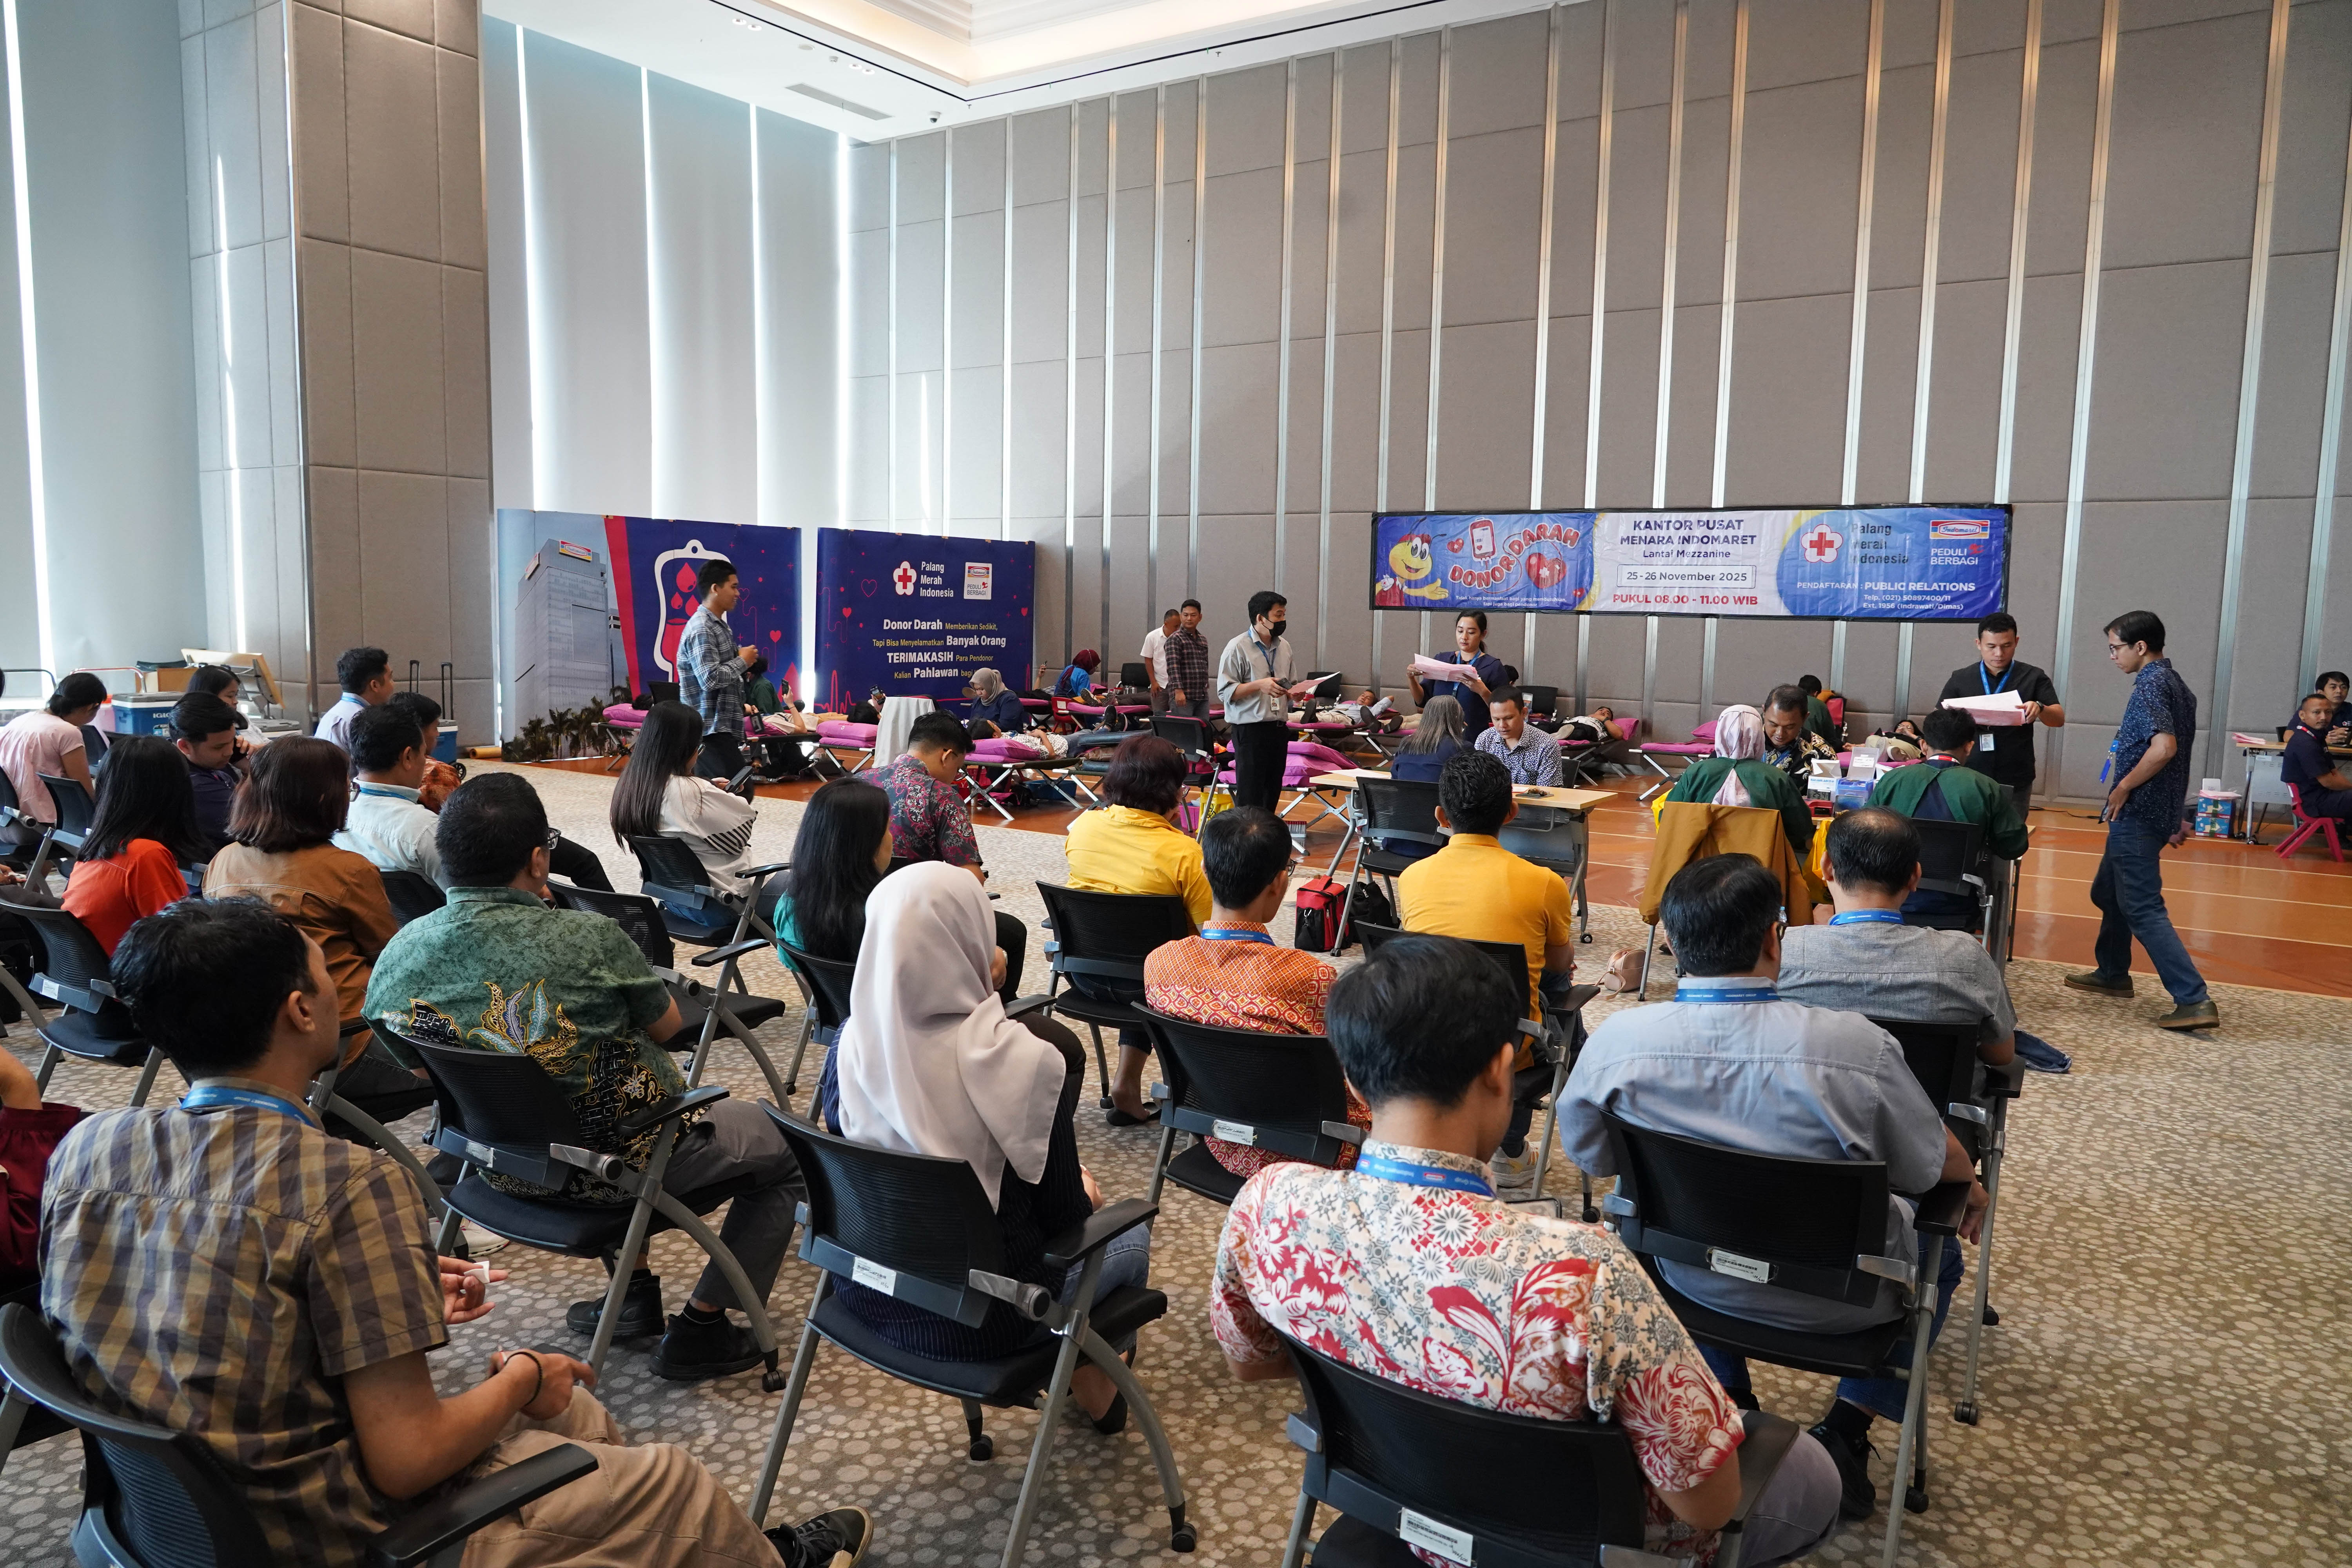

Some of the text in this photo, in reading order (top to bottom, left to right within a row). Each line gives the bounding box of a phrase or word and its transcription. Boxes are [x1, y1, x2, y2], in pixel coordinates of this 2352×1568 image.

[1634, 519, 1744, 530] KANTOR PUSAT
[1851, 523, 1891, 535] Palang
[1621, 535, 1757, 545] MENARA INDOMARET
[1449, 523, 1580, 588] DONOR DARAH
[1643, 550, 1731, 558] Lantai Mezzanine
[921, 561, 944, 573] Palang
[920, 575, 942, 585] Merah
[1660, 572, 1715, 581] November
[1719, 573, 1747, 581] 2025
[920, 587, 954, 597] Indonesia
[1909, 583, 1975, 591] RELATIONS
[1613, 593, 1651, 603] PUKUL
[1655, 595, 1689, 604] 08.00
[1700, 595, 1729, 604] 11.00
[1733, 596, 1758, 605] WIB
[884, 619, 912, 630] Donor
[914, 619, 942, 630] Darah
[873, 639, 885, 648] Tapi
[946, 636, 979, 648] Banyak
[981, 636, 1006, 648] Orang
[887, 652, 953, 663] TERIMAKASIH
[914, 667, 958, 678] Pahlawan
[961, 669, 973, 677] bagi
